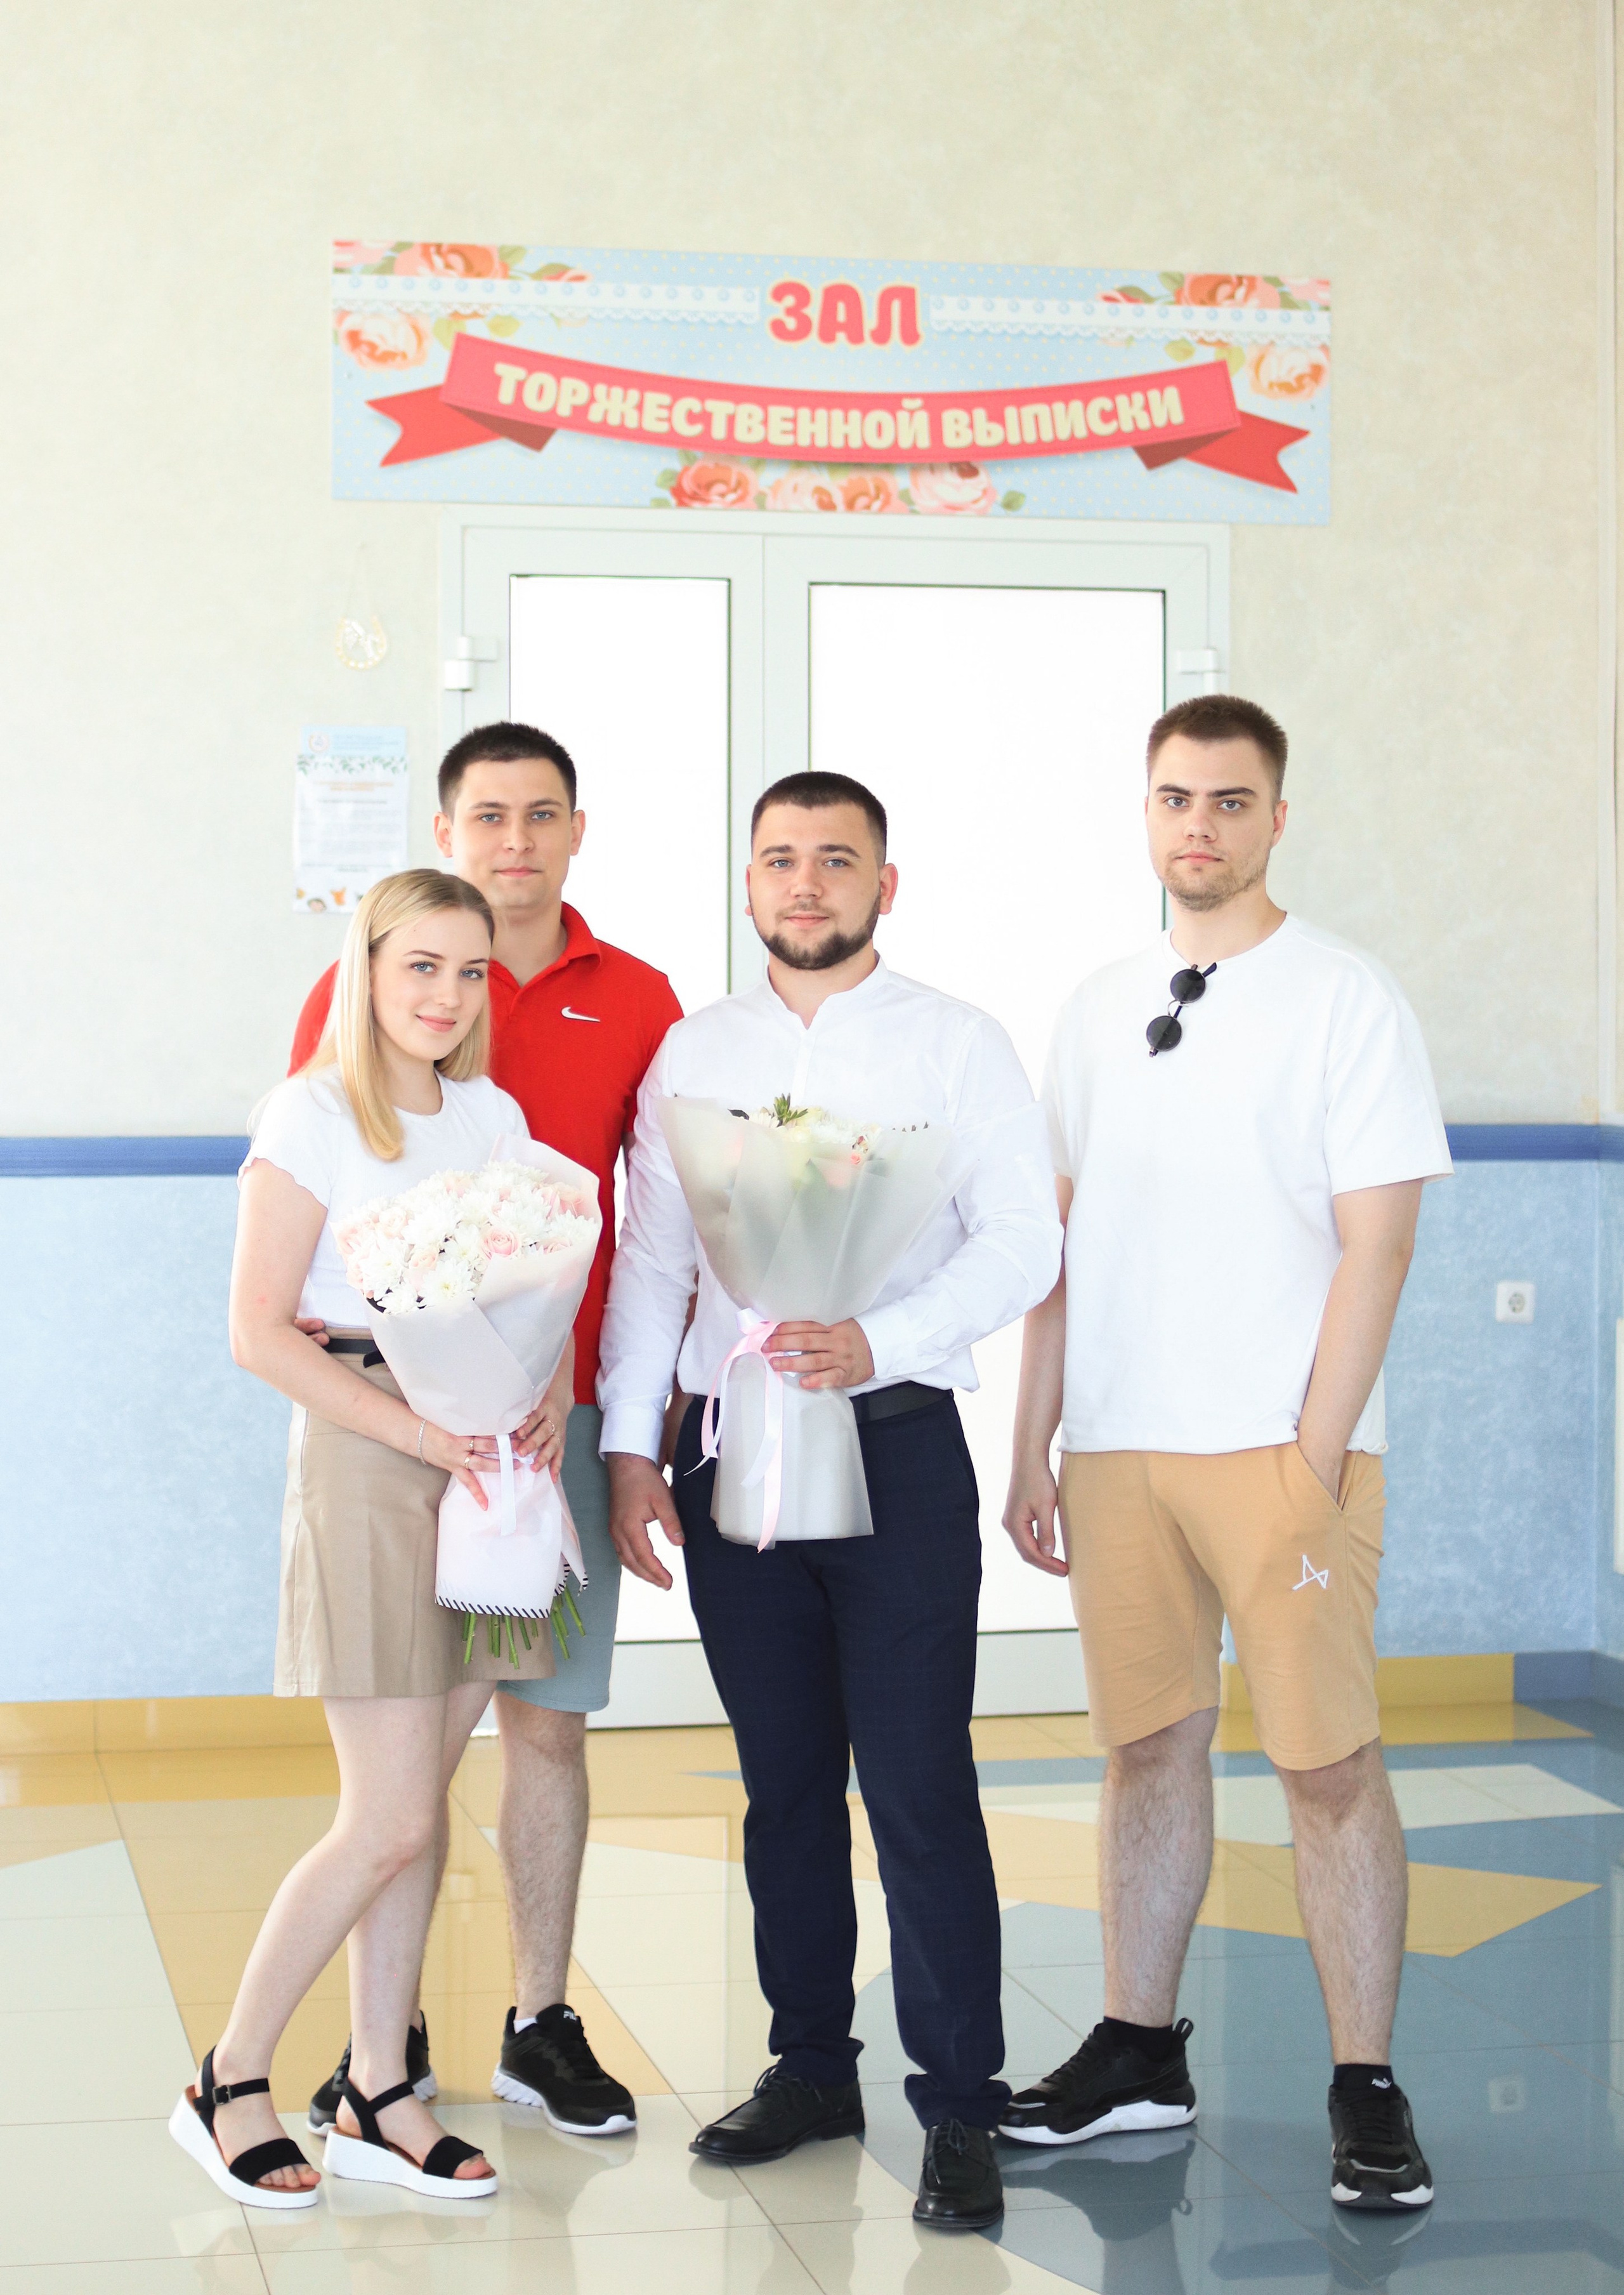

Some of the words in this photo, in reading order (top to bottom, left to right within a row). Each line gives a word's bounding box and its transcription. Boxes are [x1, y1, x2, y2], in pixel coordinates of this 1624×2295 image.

[770, 280, 920, 346] ЗАЛ
[494, 363, 931, 450] ТОРЖЕСТВЕННОЙ
[941, 386, 1184, 449] ВЫПИСКИ
[563, 2010, 577, 2021] FIL
